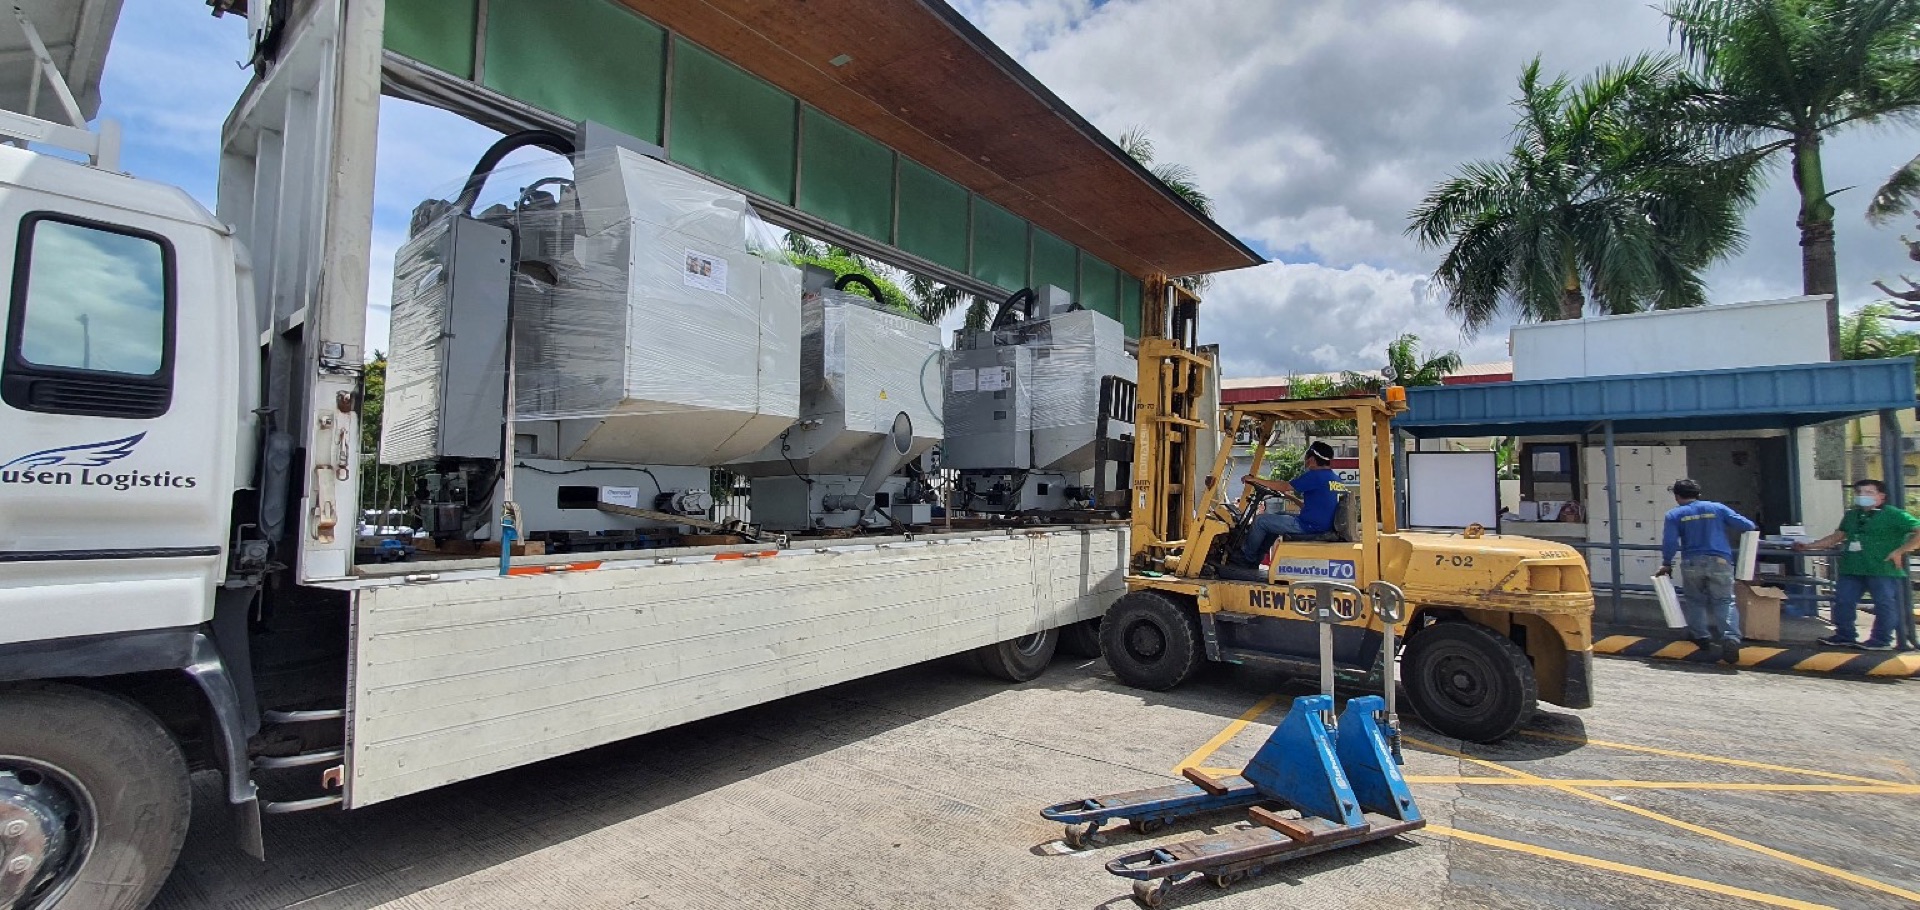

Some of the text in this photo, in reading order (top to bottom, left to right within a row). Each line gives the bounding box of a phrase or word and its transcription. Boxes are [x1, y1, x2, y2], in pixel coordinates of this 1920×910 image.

[81, 468, 197, 491] Logistics
[1278, 561, 1354, 579] KOMATSU 70
[1435, 554, 1474, 567] 7-02
[1249, 589, 1286, 611] NEW
